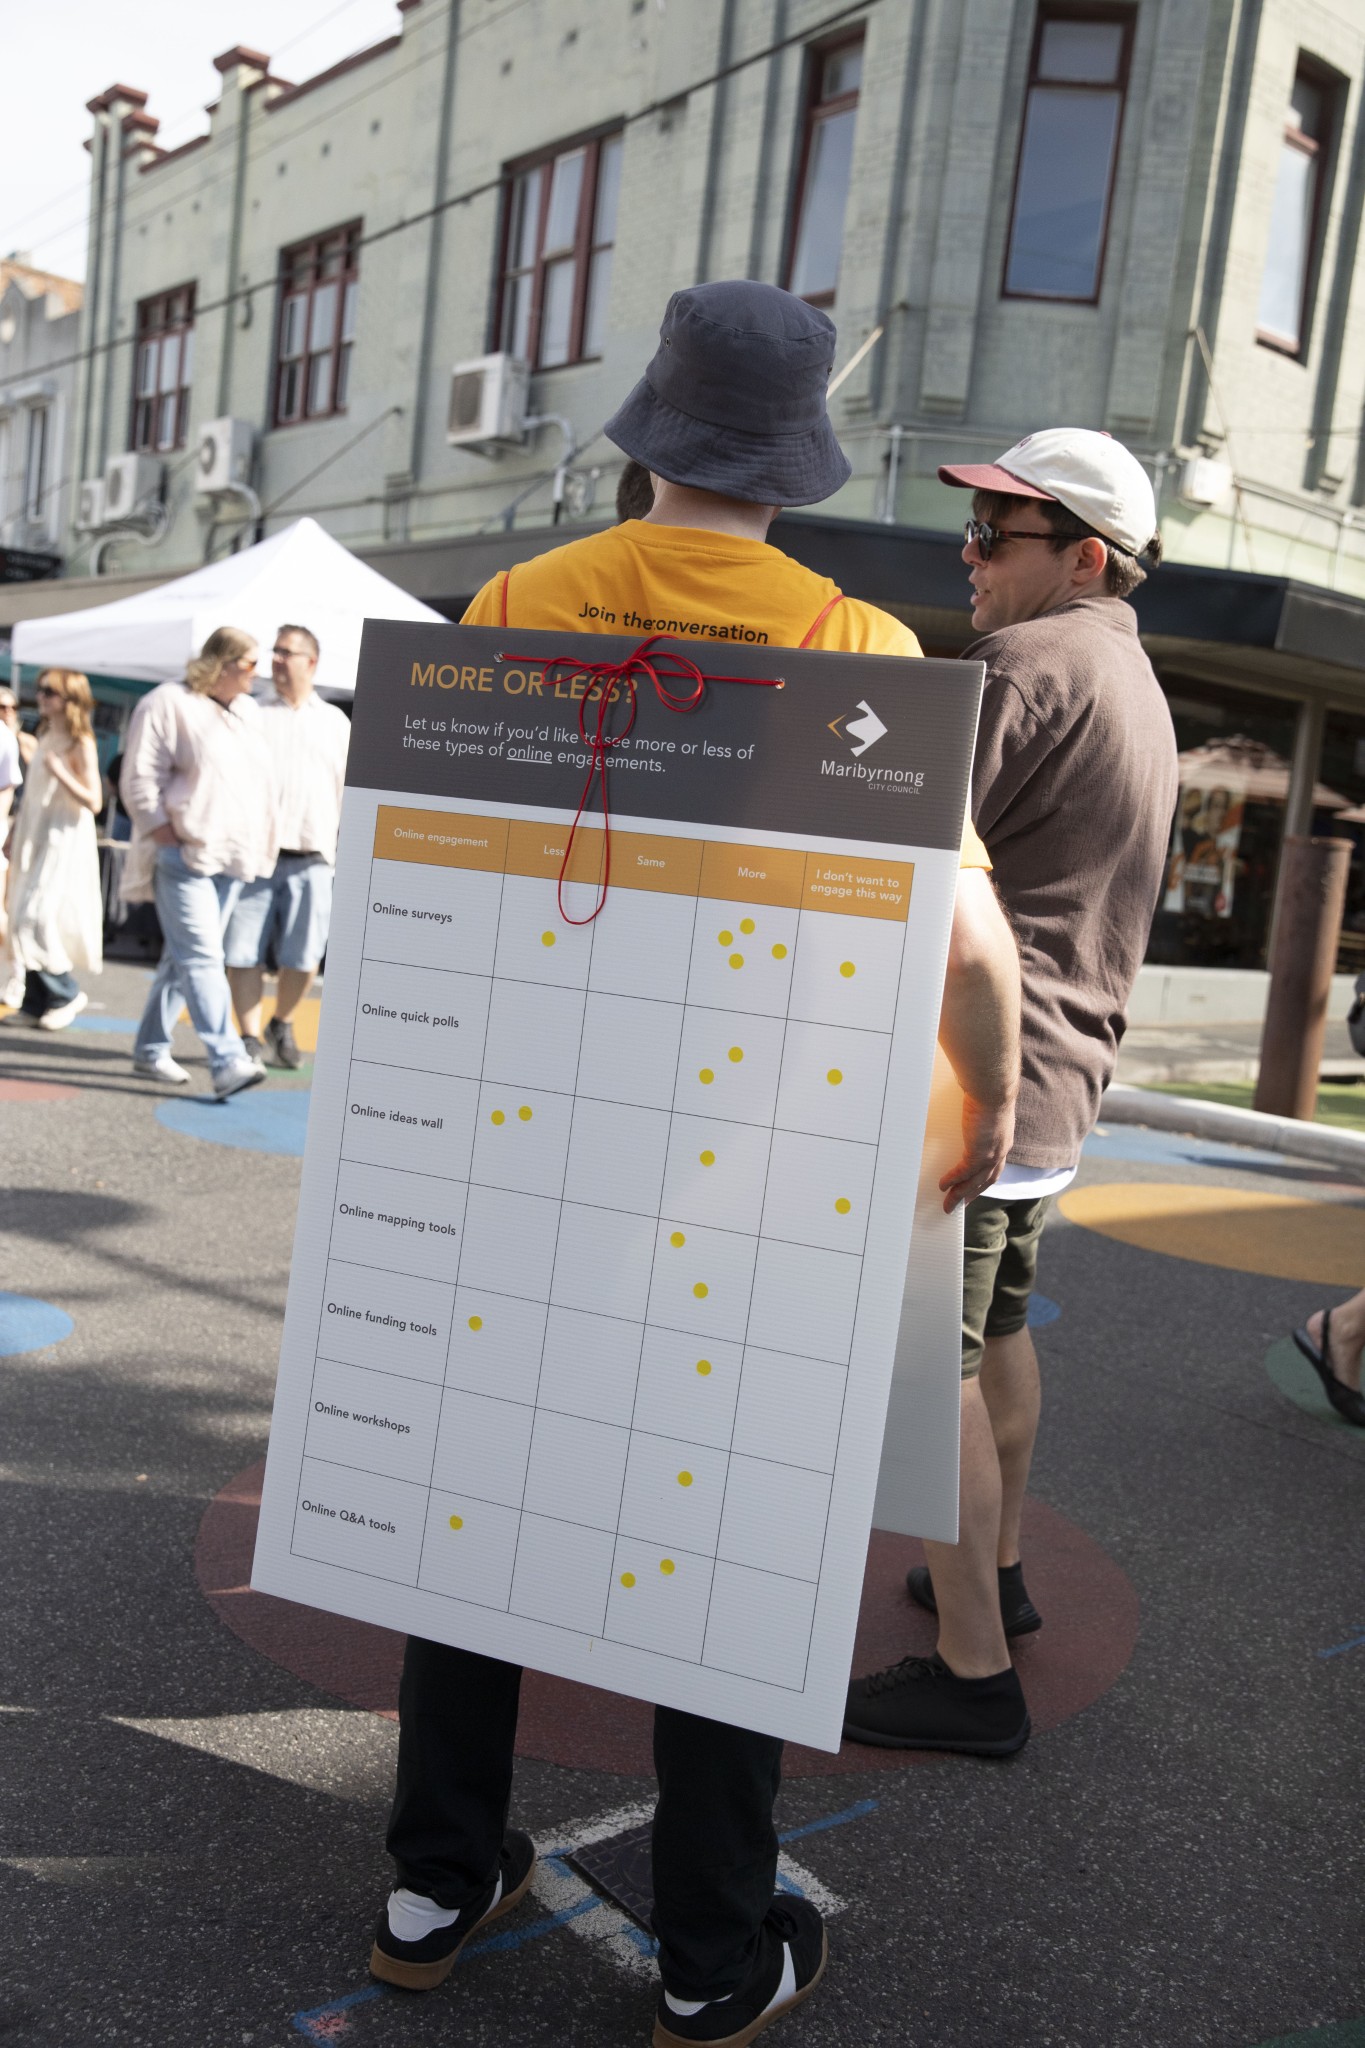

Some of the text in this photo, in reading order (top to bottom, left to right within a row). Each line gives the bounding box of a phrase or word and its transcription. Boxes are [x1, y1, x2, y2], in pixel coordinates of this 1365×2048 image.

[579, 602, 768, 644] Join the onversation
[411, 662, 638, 703] MORE OR LESS?
[405, 715, 427, 730] Let
[431, 721, 446, 731] us
[452, 718, 489, 736] know
[494, 723, 504, 736] if
[554, 727, 578, 743] like
[604, 736, 630, 748] see
[636, 739, 676, 752] more
[681, 742, 698, 754] or
[703, 740, 732, 758] less
[737, 744, 755, 759] of
[403, 735, 666, 773] these types of online engagements.
[821, 760, 924, 787] Maribyrnong
[868, 783, 920, 794] CITY COUNCIL
[394, 828, 488, 848] Online engagement
[544, 845, 565, 856] Less
[636, 855, 666, 868] Same
[738, 867, 766, 880] More
[816, 869, 820, 878] I
[856, 876, 885, 886] want
[888, 878, 899, 888] to
[810, 884, 902, 904] engage this way
[373, 903, 453, 924] Online surveys
[362, 1003, 459, 1028] Online quick polls
[351, 1104, 443, 1129] Online ideas wall
[339, 1204, 456, 1236] Online mapping tools
[327, 1303, 437, 1336] Online funding tools
[315, 1402, 410, 1434] Online workshops
[302, 1500, 396, 1534] Online Q&A tools
